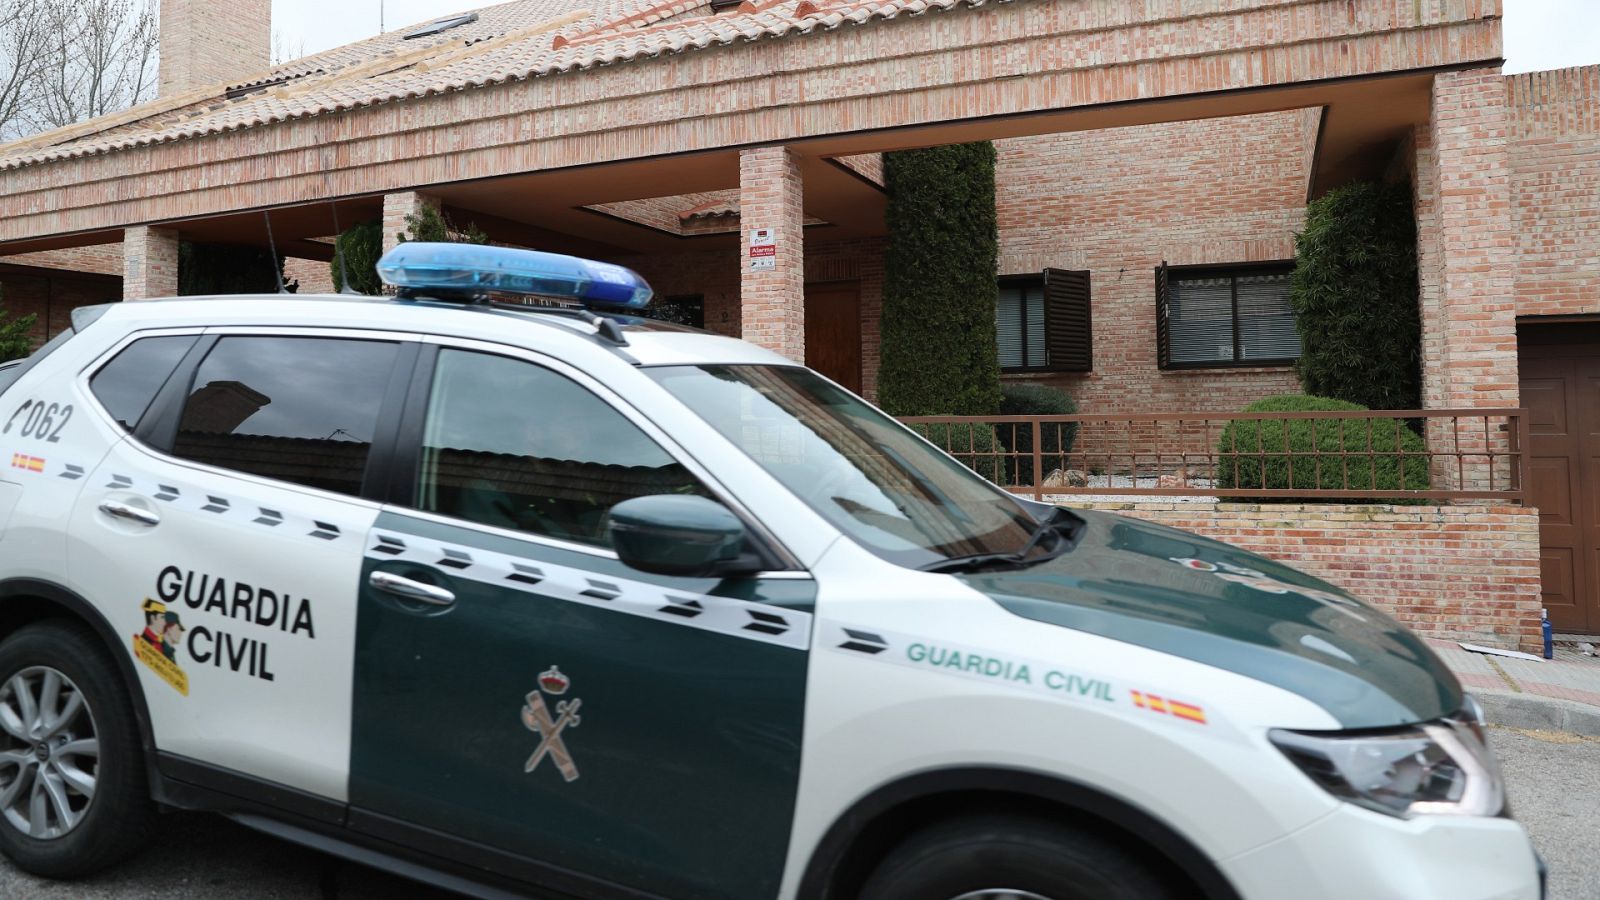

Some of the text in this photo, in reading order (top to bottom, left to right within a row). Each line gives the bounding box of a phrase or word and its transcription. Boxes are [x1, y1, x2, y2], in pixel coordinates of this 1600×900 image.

[20, 400, 73, 443] 062
[156, 565, 316, 639] GUARDIA
[187, 625, 275, 682] CIVIL
[906, 643, 1116, 702] GUARDIA CIVIL
